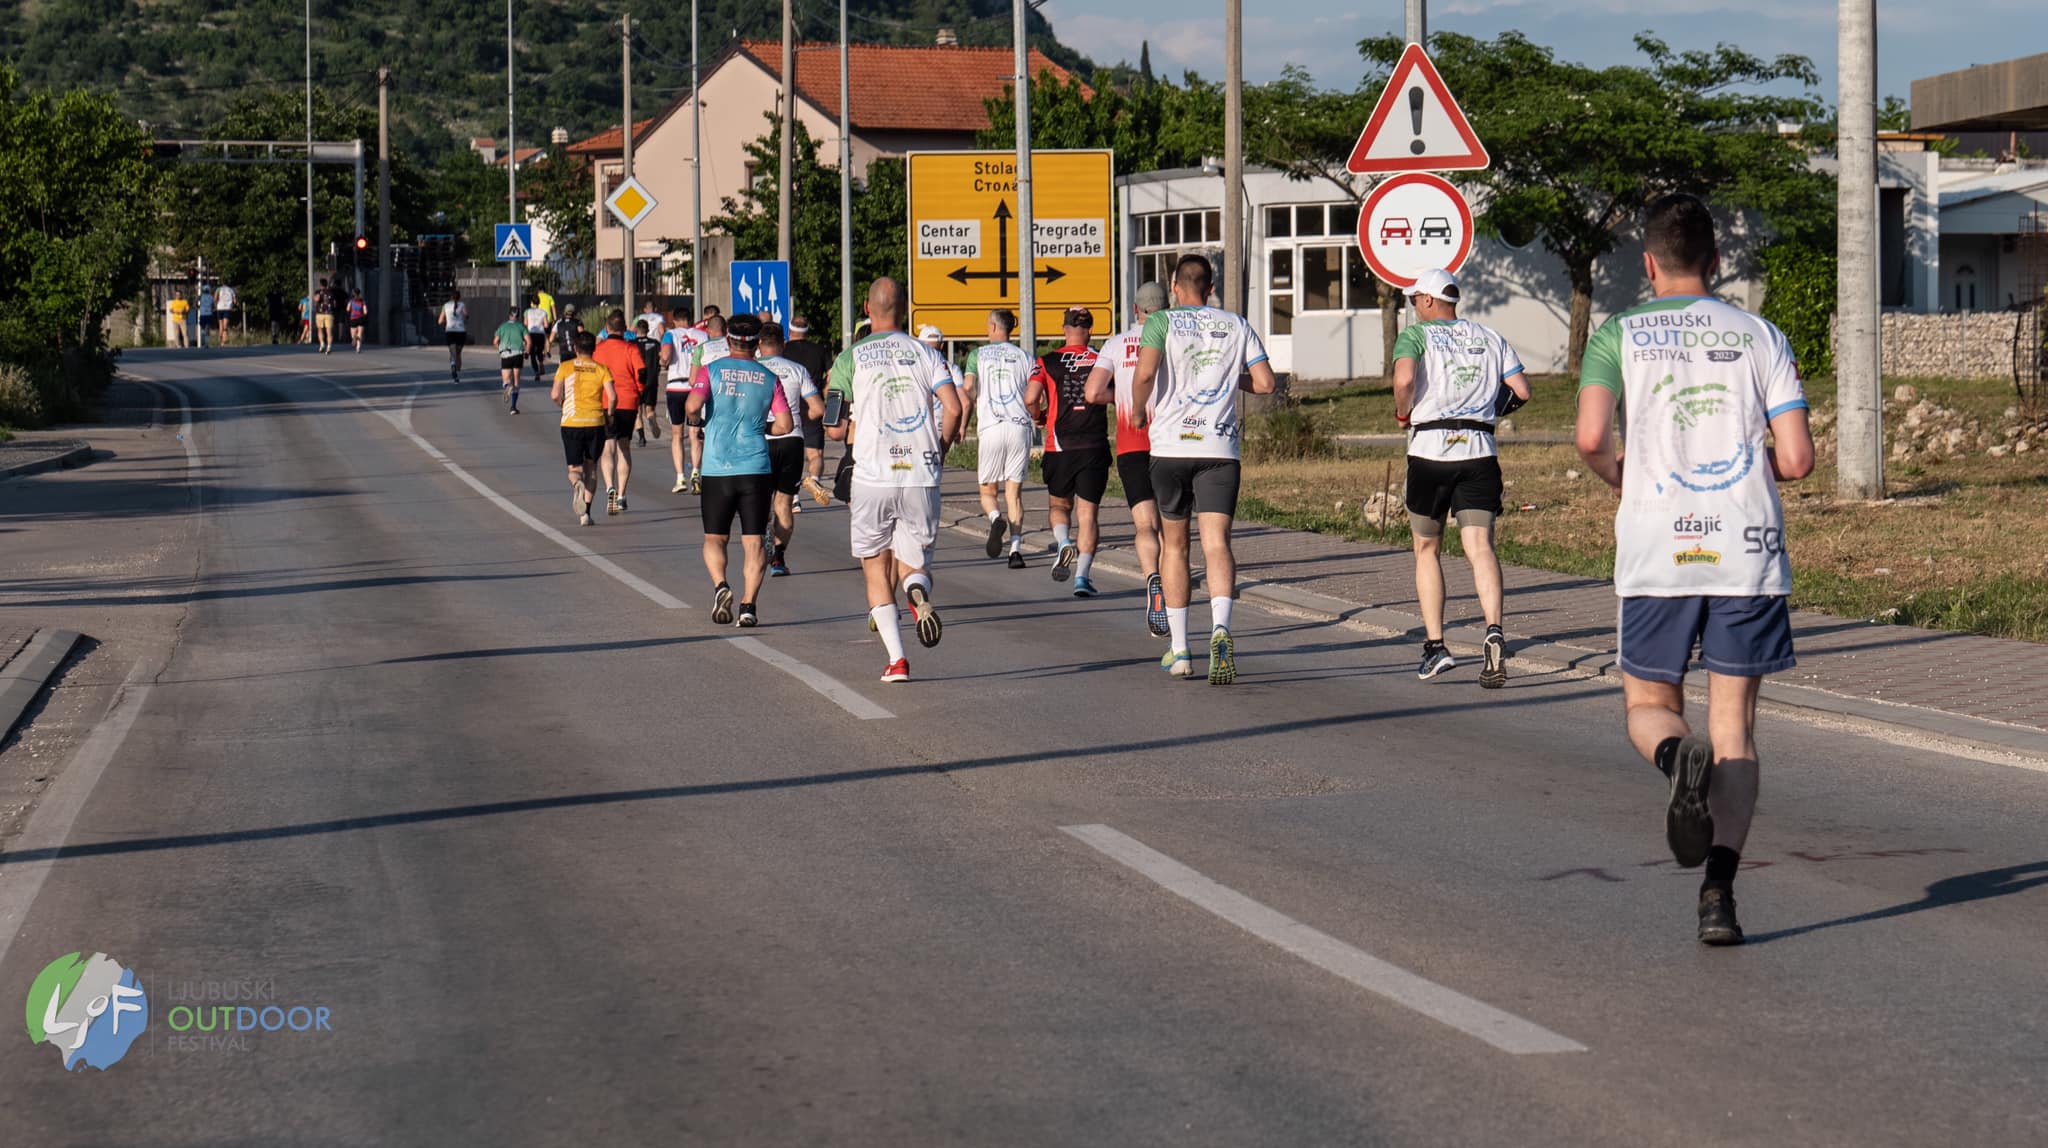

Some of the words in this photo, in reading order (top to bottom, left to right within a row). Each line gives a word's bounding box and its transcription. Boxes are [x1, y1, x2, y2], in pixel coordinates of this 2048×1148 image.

[974, 160, 1017, 175] Stola
[974, 178, 1018, 192] Стола
[921, 224, 971, 238] Centar
[921, 241, 977, 258] Центар
[1629, 312, 1712, 329] LJUBUŠKI
[1632, 329, 1754, 350] OUTDOOR
[1633, 349, 1693, 363] FESTIVAL
[1713, 351, 1735, 360] 2023
[1674, 512, 1722, 536] džajić
[1675, 551, 1718, 564] pfanner
